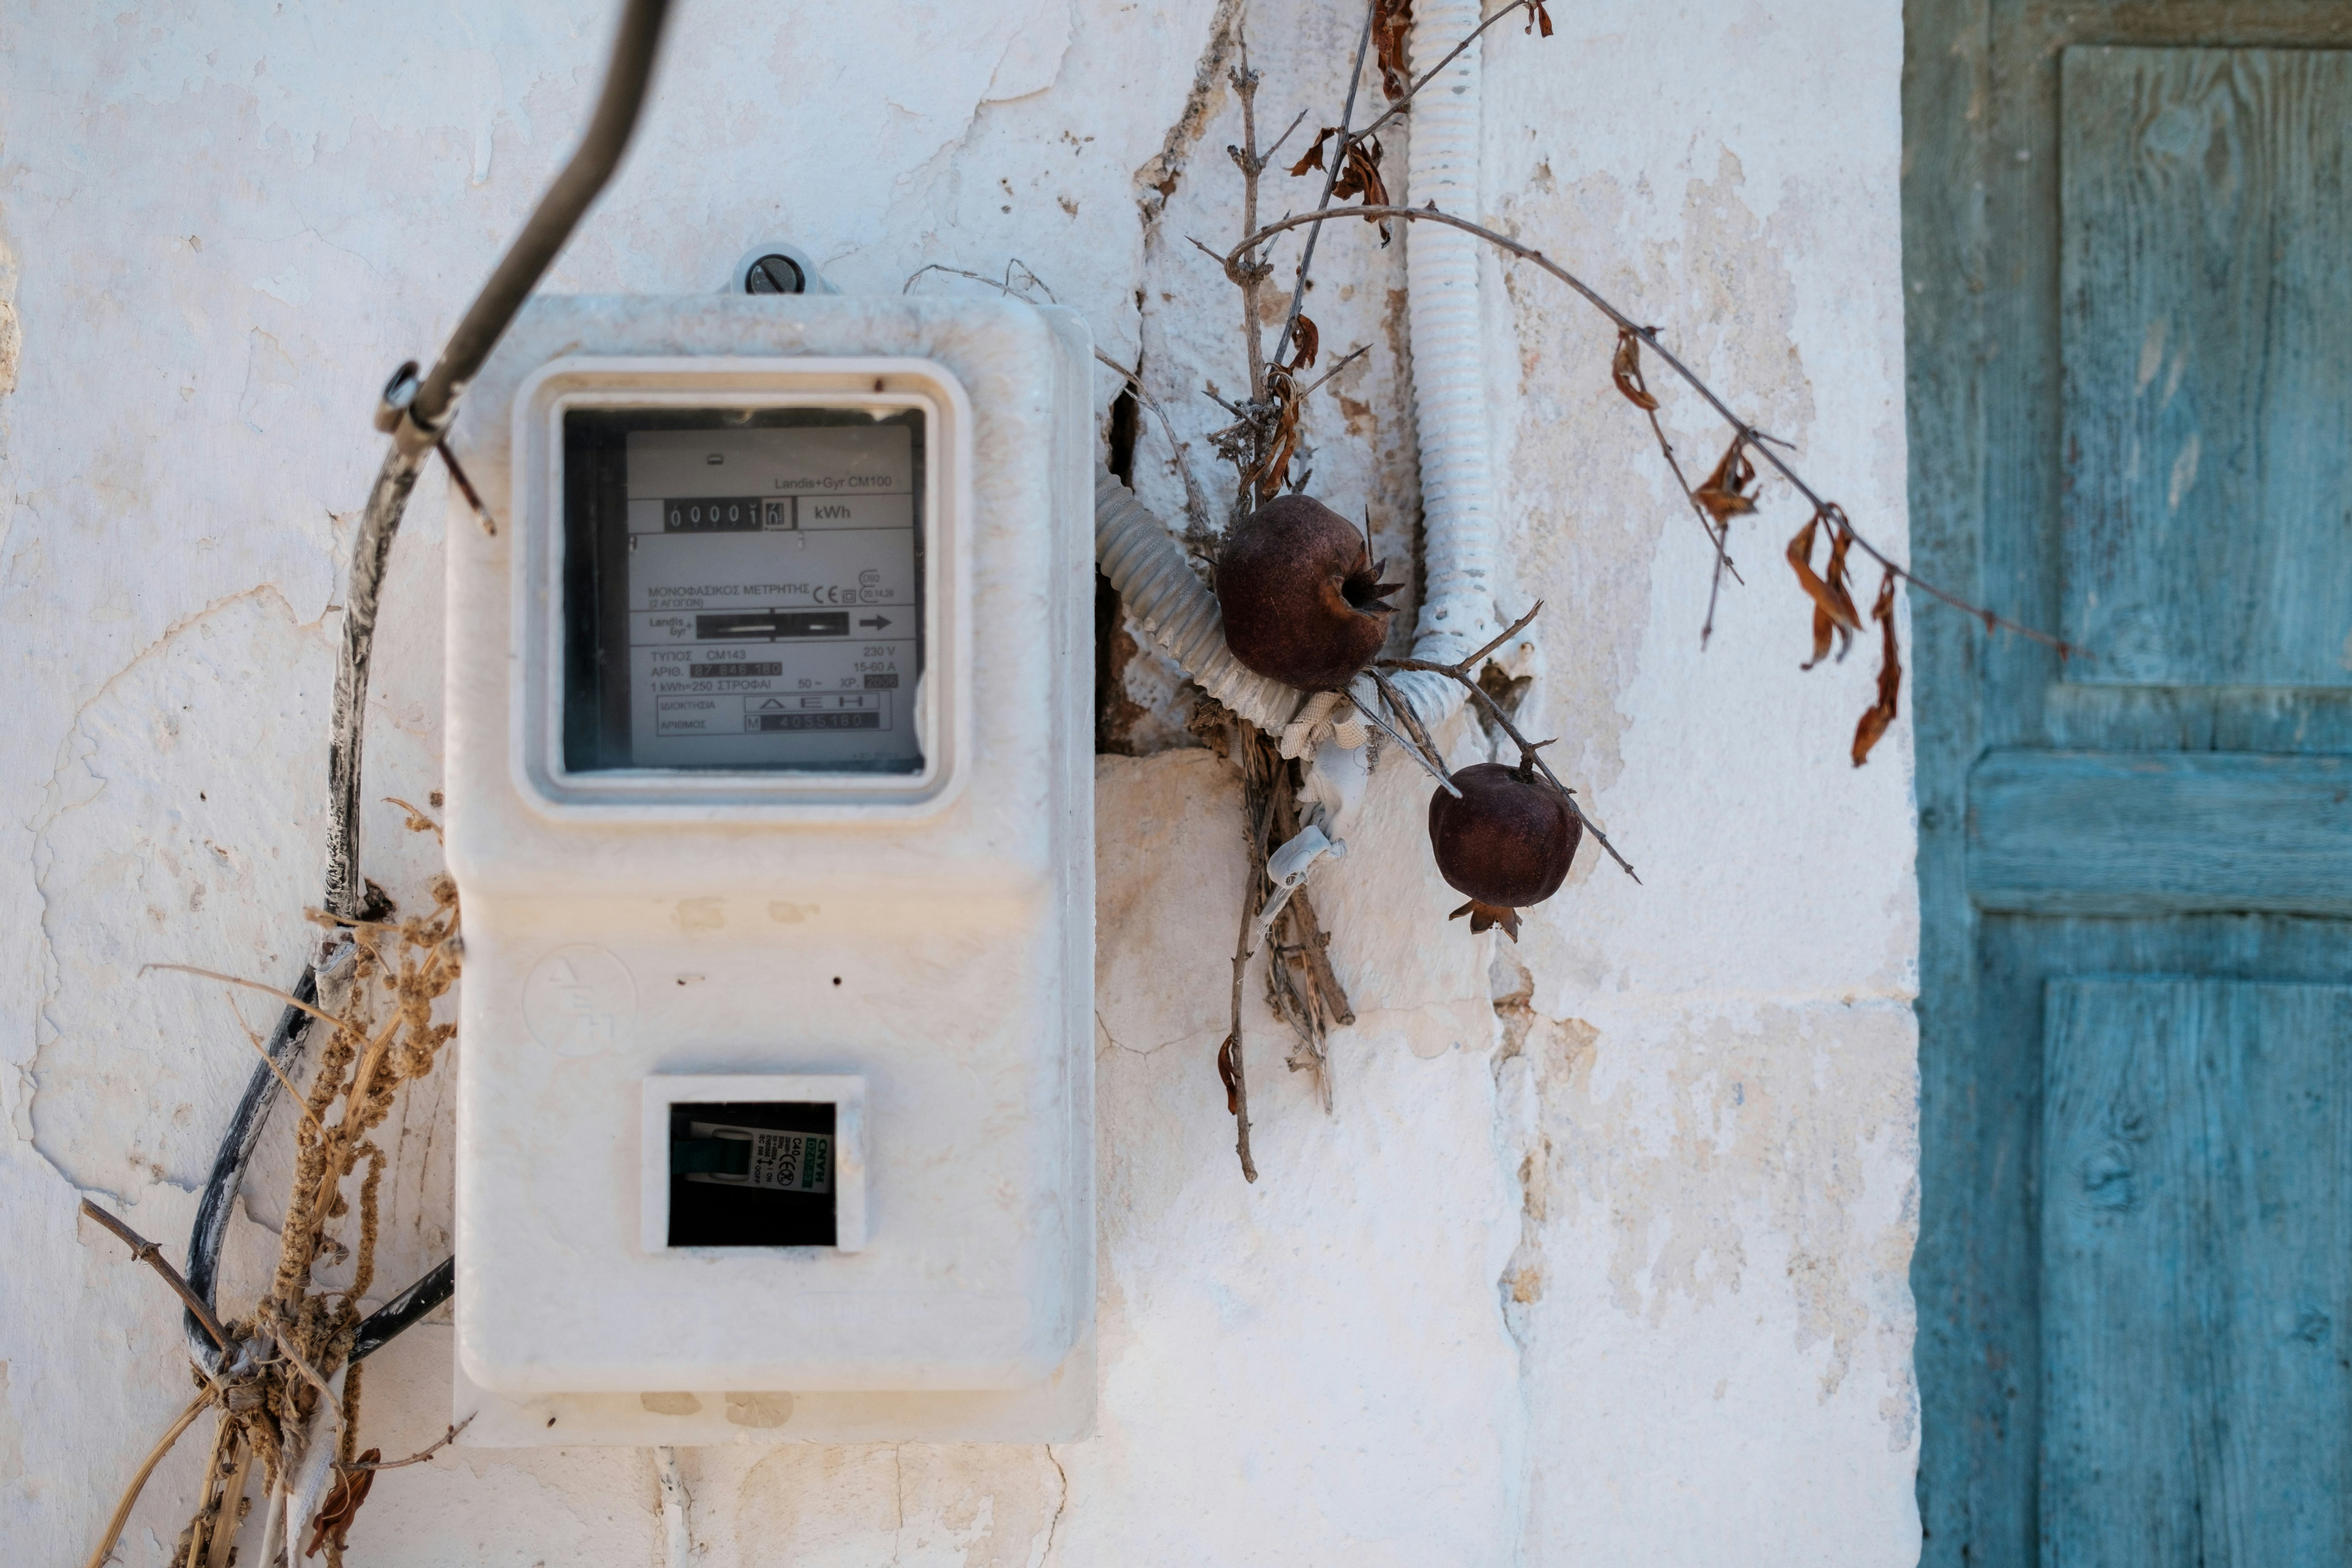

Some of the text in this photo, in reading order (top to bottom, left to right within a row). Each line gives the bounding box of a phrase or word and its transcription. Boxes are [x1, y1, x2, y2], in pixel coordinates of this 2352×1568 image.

[775, 475, 892, 490] Landis+Gyr CM100
[814, 505, 851, 519] kWh
[648, 583, 810, 597] ΜΟΝΟΦΑΣΙΚΟΣ ΜΕΤΡΗΤΗΣ
[649, 617, 684, 627] Landis
[670, 627, 686, 638] Gyr
[651, 650, 747, 662] ΤΥΠΟΣ CM143
[863, 647, 896, 657] 230 V
[651, 667, 684, 678] ΑΡΙΘ.
[853, 662, 896, 672] 15-60 A
[651, 679, 772, 692] 1 kWh=250 ΣΤΡΟΦΑΙ
[798, 678, 813, 689] 50
[661, 701, 715, 711] ΙΔΙΟΚΤΗΣΙΑ
[760, 696, 863, 709] ΔΕΗ
[661, 720, 706, 730] ΑΡΙΘΜΟΣ
[792, 1138, 802, 1156] C40
[804, 1140, 815, 1181] DZ47-63
[766, 1172, 773, 1182] ON
